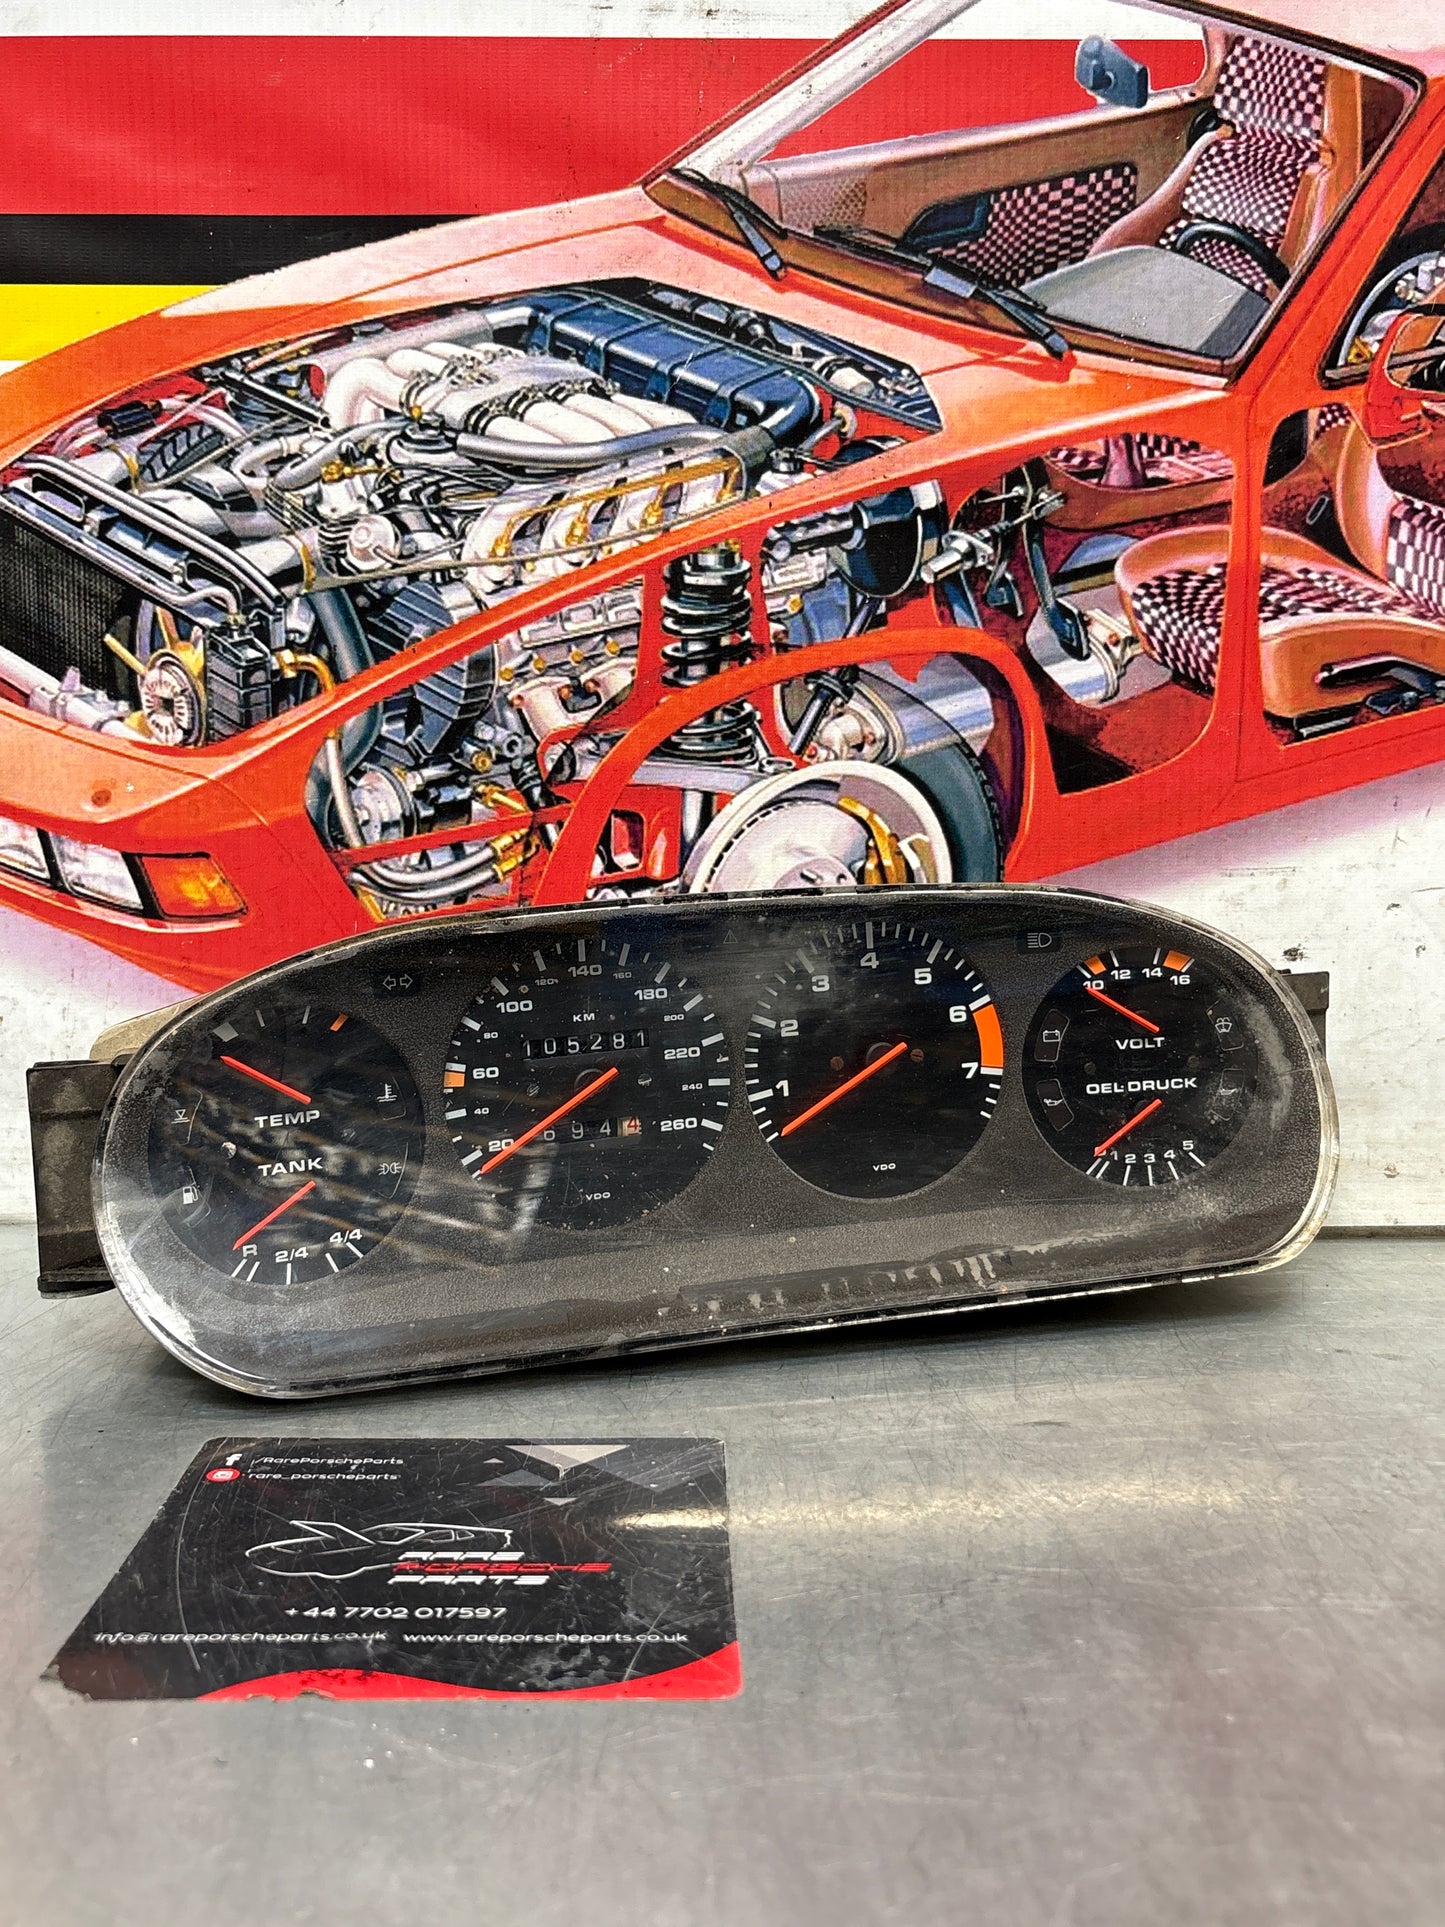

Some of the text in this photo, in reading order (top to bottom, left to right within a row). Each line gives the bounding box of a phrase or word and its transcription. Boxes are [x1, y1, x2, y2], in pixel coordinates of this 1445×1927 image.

[860, 951, 879, 969] 4
[568, 964, 602, 977] 140
[612, 971, 632, 980] 160
[914, 967, 932, 985] 5
[1110, 969, 1131, 980] 12
[1141, 967, 1162, 979] 14
[811, 974, 830, 992] 3
[1082, 980, 1105, 991] 10
[1169, 974, 1191, 986] 16
[634, 987, 668, 1000] 180
[496, 1000, 533, 1013] 100
[572, 1013, 596, 1022] KM
[663, 1013, 685, 1022] 200
[949, 1005, 967, 1023] 6
[780, 1019, 799, 1037] 2
[483, 1031, 499, 1040] 80
[1115, 1036, 1165, 1050] VOLT
[664, 1046, 701, 1060] 220
[472, 1066, 499, 1079] 60
[961, 1061, 979, 1079] 7
[681, 1082, 703, 1091] 240
[775, 1079, 790, 1097] 1
[473, 1107, 490, 1115] 40
[254, 1109, 321, 1129] TEMP
[660, 1117, 698, 1131] 260
[488, 1138, 514, 1152] 20
[1182, 1140, 1194, 1151] 5
[1109, 1150, 1118, 1161] 1
[1124, 1153, 1137, 1164] 2
[1143, 1153, 1156, 1164] 3
[1163, 1149, 1176, 1160] 4
[258, 1156, 323, 1177] TANK
[872, 1162, 896, 1171] VDO
[585, 1191, 611, 1201] VDO
[329, 1228, 363, 1245] 4/4
[242, 1244, 258, 1257] R
[274, 1246, 309, 1263] 2/4
[343, 1606, 409, 1619] 7702
[414, 1606, 507, 1619] 017597
[402, 1632, 689, 1643] www.rareporscheparts.co.uk
